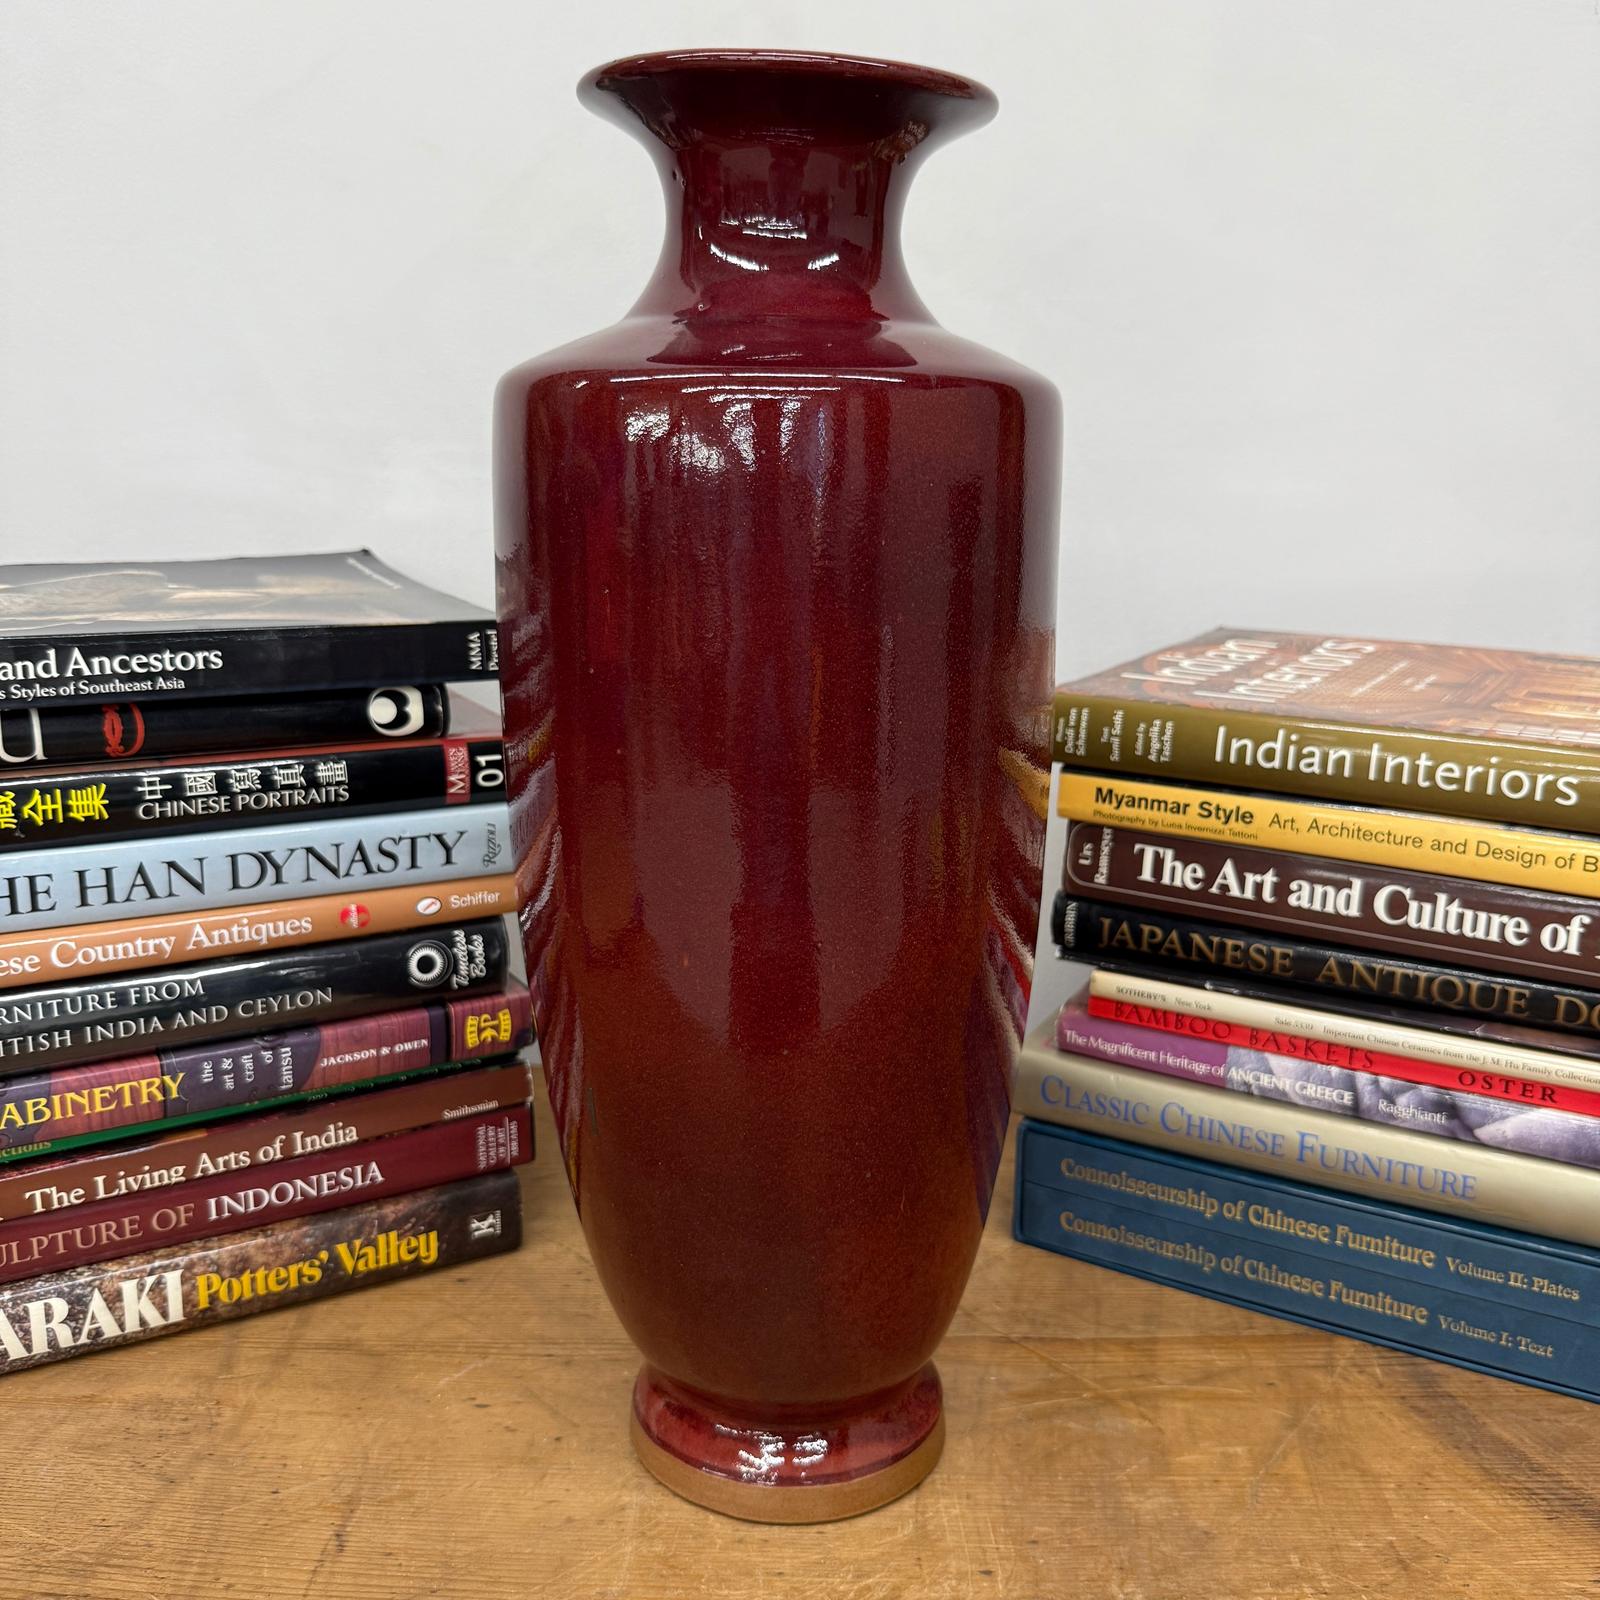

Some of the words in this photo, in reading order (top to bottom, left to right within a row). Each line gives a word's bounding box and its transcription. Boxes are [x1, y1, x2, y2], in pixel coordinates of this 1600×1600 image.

[0, 648, 60, 681] and
[64, 647, 223, 677] Ancestors
[467, 631, 482, 670] MMA
[11, 683, 56, 701] Styles
[60, 681, 76, 696] of
[79, 678, 153, 694] Southeast
[156, 677, 185, 690] Asia
[1112, 709, 1125, 735] Sethi
[1148, 719, 1162, 763] Angelika
[1160, 721, 1174, 763] Taschen
[1110, 736, 1121, 762] Sunil
[1214, 725, 1351, 778] Indian
[1368, 743, 1581, 806] Interiors
[475, 754, 504, 787] 01
[138, 795, 231, 820] CHINESE
[236, 786, 349, 811] PORTRAITS
[1093, 810, 1146, 825] Photography
[1148, 818, 1158, 827] by
[1094, 787, 1191, 815] Myanmar
[1197, 801, 1254, 825] Style
[1268, 813, 1299, 833] Art,
[1307, 818, 1423, 849] Architecture
[1430, 838, 1468, 855] and
[1475, 840, 1546, 868] Design
[1554, 852, 1576, 869] of
[73, 856, 208, 908] HAN
[225, 830, 467, 892] DYNASTY
[1078, 842, 1094, 866] Urs
[450, 891, 500, 908] Schiffer
[1133, 843, 1205, 891] The
[1208, 857, 1281, 904] Art
[1287, 877, 1363, 918] and
[1373, 884, 1530, 946] Culture
[1540, 914, 1592, 956] of
[50, 935, 176, 968] Country
[186, 916, 312, 951] Antiques
[451, 929, 470, 990] Timeless
[468, 933, 487, 978] Books
[1100, 916, 1295, 969] JAPANESE
[1315, 956, 1532, 1018] ANTIQUE
[130, 979, 204, 1007] FROM
[84, 1016, 163, 1043] INDIA
[167, 1004, 228, 1030] AND
[235, 986, 332, 1018] CEYLON
[1116, 986, 1166, 1002] SOTHEBY'S
[1323, 1026, 1364, 1041] Important
[1366, 1034, 1400, 1047] Chinese
[1401, 1040, 1441, 1055] Ceramics
[1443, 1049, 1465, 1059] from
[1466, 1053, 1480, 1063] the
[1504, 1059, 1519, 1069] Hu
[1522, 1062, 1552, 1077] Family
[1554, 1068, 1600, 1084] Collection
[201, 1060, 214, 1082] the
[221, 1057, 233, 1070] &
[241, 1053, 254, 1082] craft
[260, 1050, 273, 1063] of
[280, 1047, 294, 1089] tansu
[320, 1048, 377, 1067] JACKSON
[381, 1046, 391, 1055] &
[393, 1039, 428, 1053] OWEN
[1113, 1001, 1232, 1039] BAMBOO
[1249, 1027, 1374, 1069] BASKETS
[1458, 1071, 1557, 1103] OSTER
[223, 1073, 235, 1090] art
[1064, 1030, 1087, 1046] The
[1088, 1036, 1159, 1063] Magnificent
[1160, 1050, 1211, 1074] Heritage
[1212, 1063, 1225, 1077] of
[1227, 1066, 1292, 1091] ANCIENT
[1295, 1079, 1354, 1105] GREECE
[1378, 1099, 1449, 1124] Ragghianti
[0, 1072, 185, 1130] ABINETRY
[443, 1099, 499, 1120] Smithsonian
[477, 1124, 487, 1170] NATIONAL
[487, 1125, 497, 1164] GALLERY
[510, 1120, 519, 1157] ABRAMS
[1040, 1074, 1150, 1126] CLASSIC
[1159, 1101, 1286, 1157] CHINESE
[1296, 1130, 1477, 1200] FURNITURE
[25, 1186, 85, 1213] The
[93, 1165, 186, 1200] Living
[194, 1151, 251, 1178] Arts
[258, 1135, 286, 1163] of
[293, 1122, 358, 1155] India
[152, 1203, 194, 1231] OF
[208, 1161, 384, 1221] INDONESIA
[1060, 1158, 1218, 1219] Connoisseurship
[1223, 1200, 1245, 1221] of
[1248, 1204, 1330, 1243] Chinese
[1336, 1224, 1436, 1269] Furniture
[1446, 1256, 1505, 1283] Volume
[1508, 1270, 1528, 1289] II:
[1532, 1276, 1581, 1301] Plates
[0, 1268, 187, 1360] ARAKI
[335, 1230, 439, 1275] Valley
[1060, 1211, 1216, 1274] Connoisseurship
[1220, 1255, 1242, 1276] of
[1243, 1259, 1326, 1298] Chinese
[1329, 1279, 1429, 1325] Furniture
[1438, 1314, 1497, 1341] Volume
[1500, 1330, 1512, 1347] I:
[1517, 1335, 1553, 1358] Text
